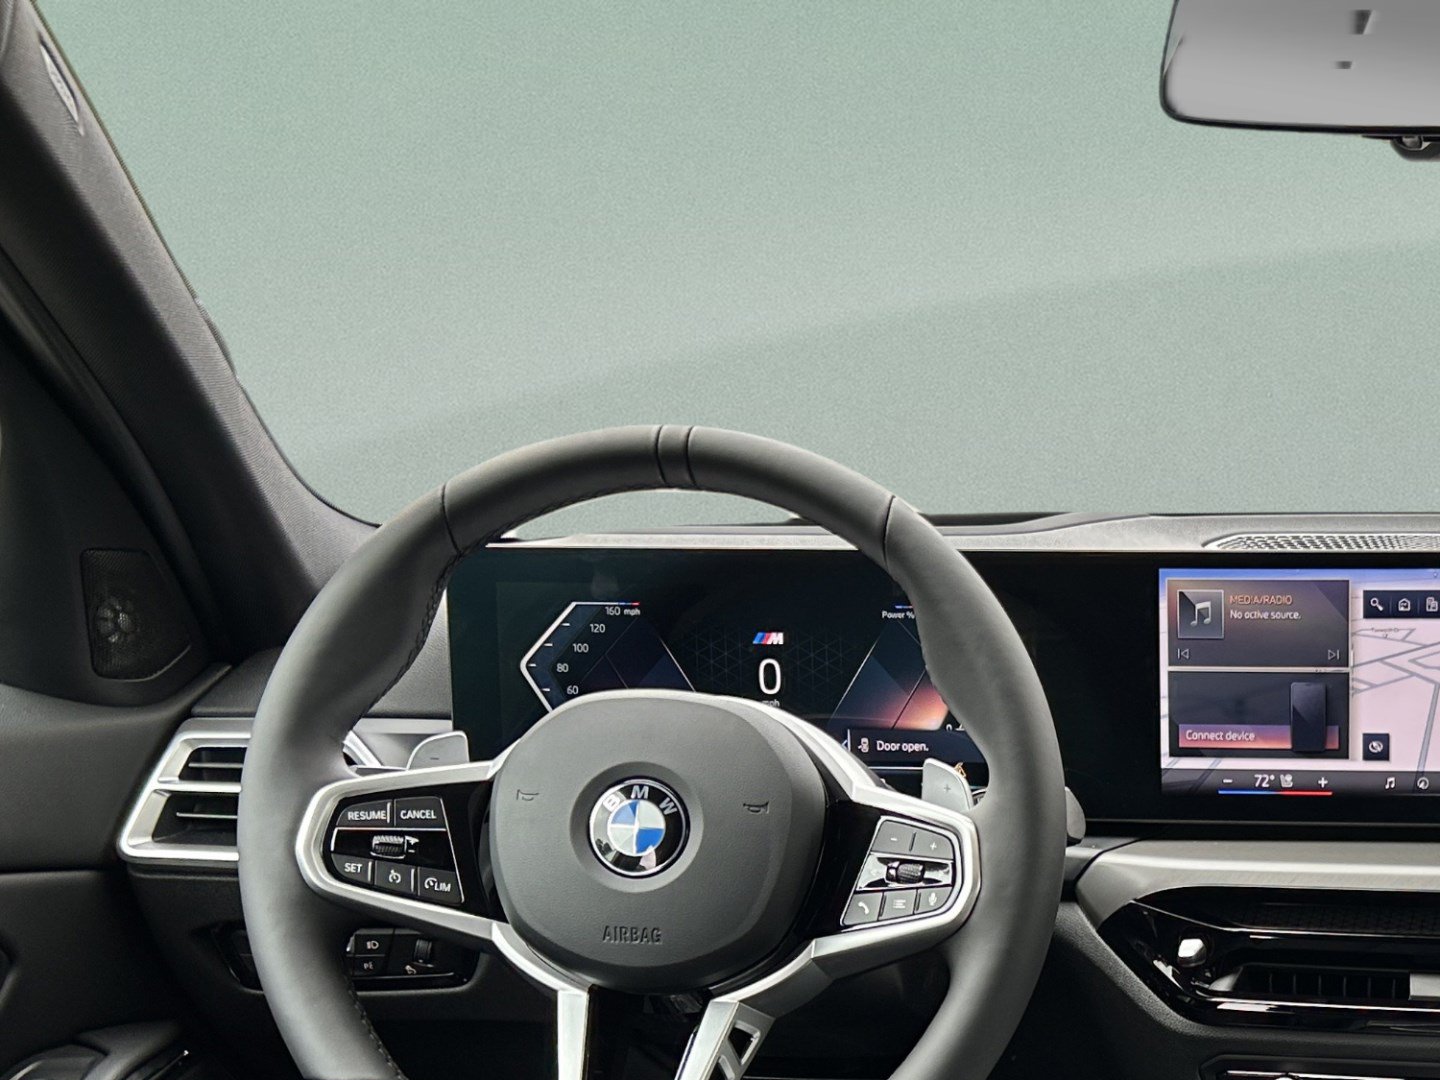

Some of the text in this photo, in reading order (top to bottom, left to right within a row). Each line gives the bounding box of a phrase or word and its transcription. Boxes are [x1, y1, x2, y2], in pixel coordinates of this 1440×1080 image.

[1230, 595, 1292, 605] MEDIA/RADIO
[605, 606, 640, 617] 160 mph
[882, 611, 915, 619] Power %
[1230, 610, 1301, 619] No active source.
[590, 624, 605, 633] 120
[573, 643, 589, 653] 100
[556, 663, 569, 672] 80
[759, 658, 782, 695] 0
[567, 685, 579, 694] 60
[1185, 729, 1255, 741] Connect device
[876, 740, 929, 753] Door open.
[602, 785, 678, 815] BMW
[347, 810, 386, 820] RESUME
[400, 810, 436, 819] CANCEL
[344, 862, 362, 873] SET
[434, 882, 451, 892] LIM
[602, 925, 663, 944] AIRBAG
